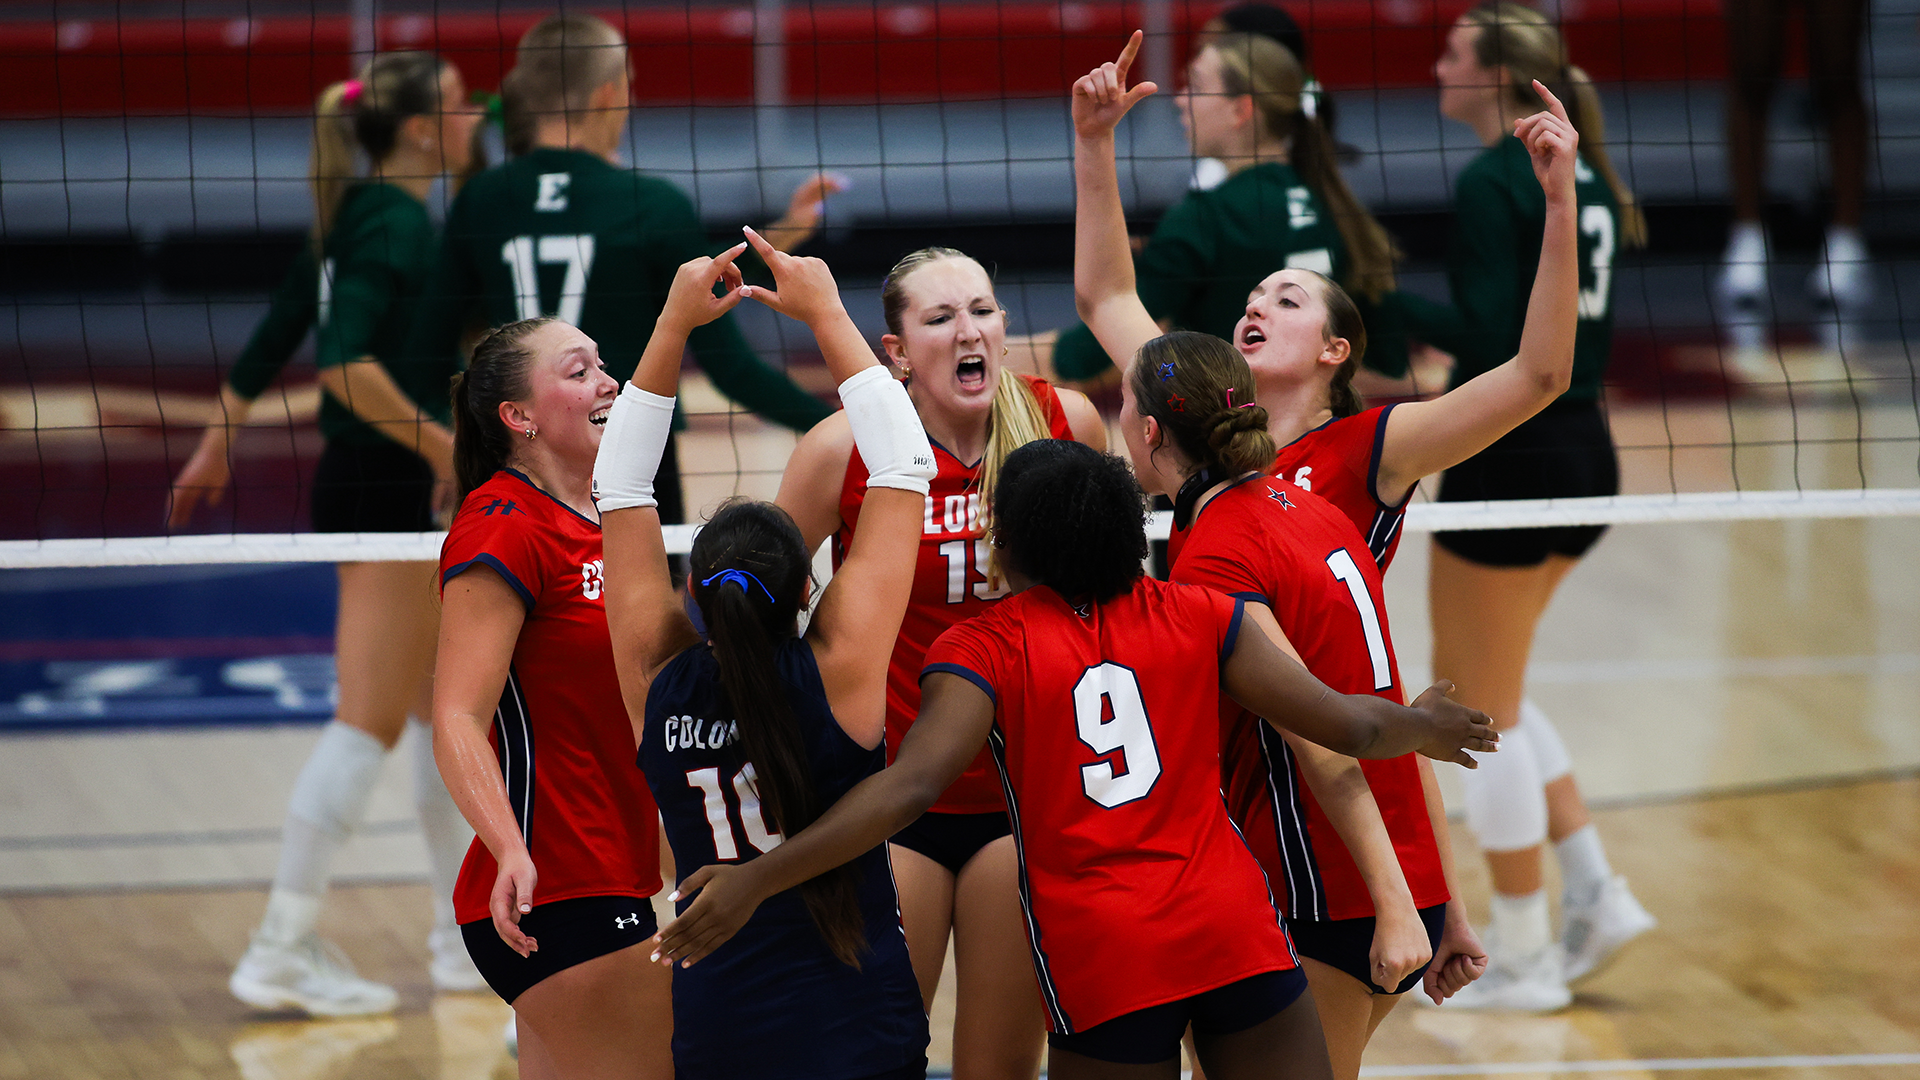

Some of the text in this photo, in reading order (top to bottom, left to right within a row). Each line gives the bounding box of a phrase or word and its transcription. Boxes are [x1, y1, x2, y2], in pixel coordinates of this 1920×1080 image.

[502, 234, 596, 327] 17
[938, 539, 1012, 604] 15
[1324, 546, 1393, 693] 1
[1071, 659, 1163, 811] 9
